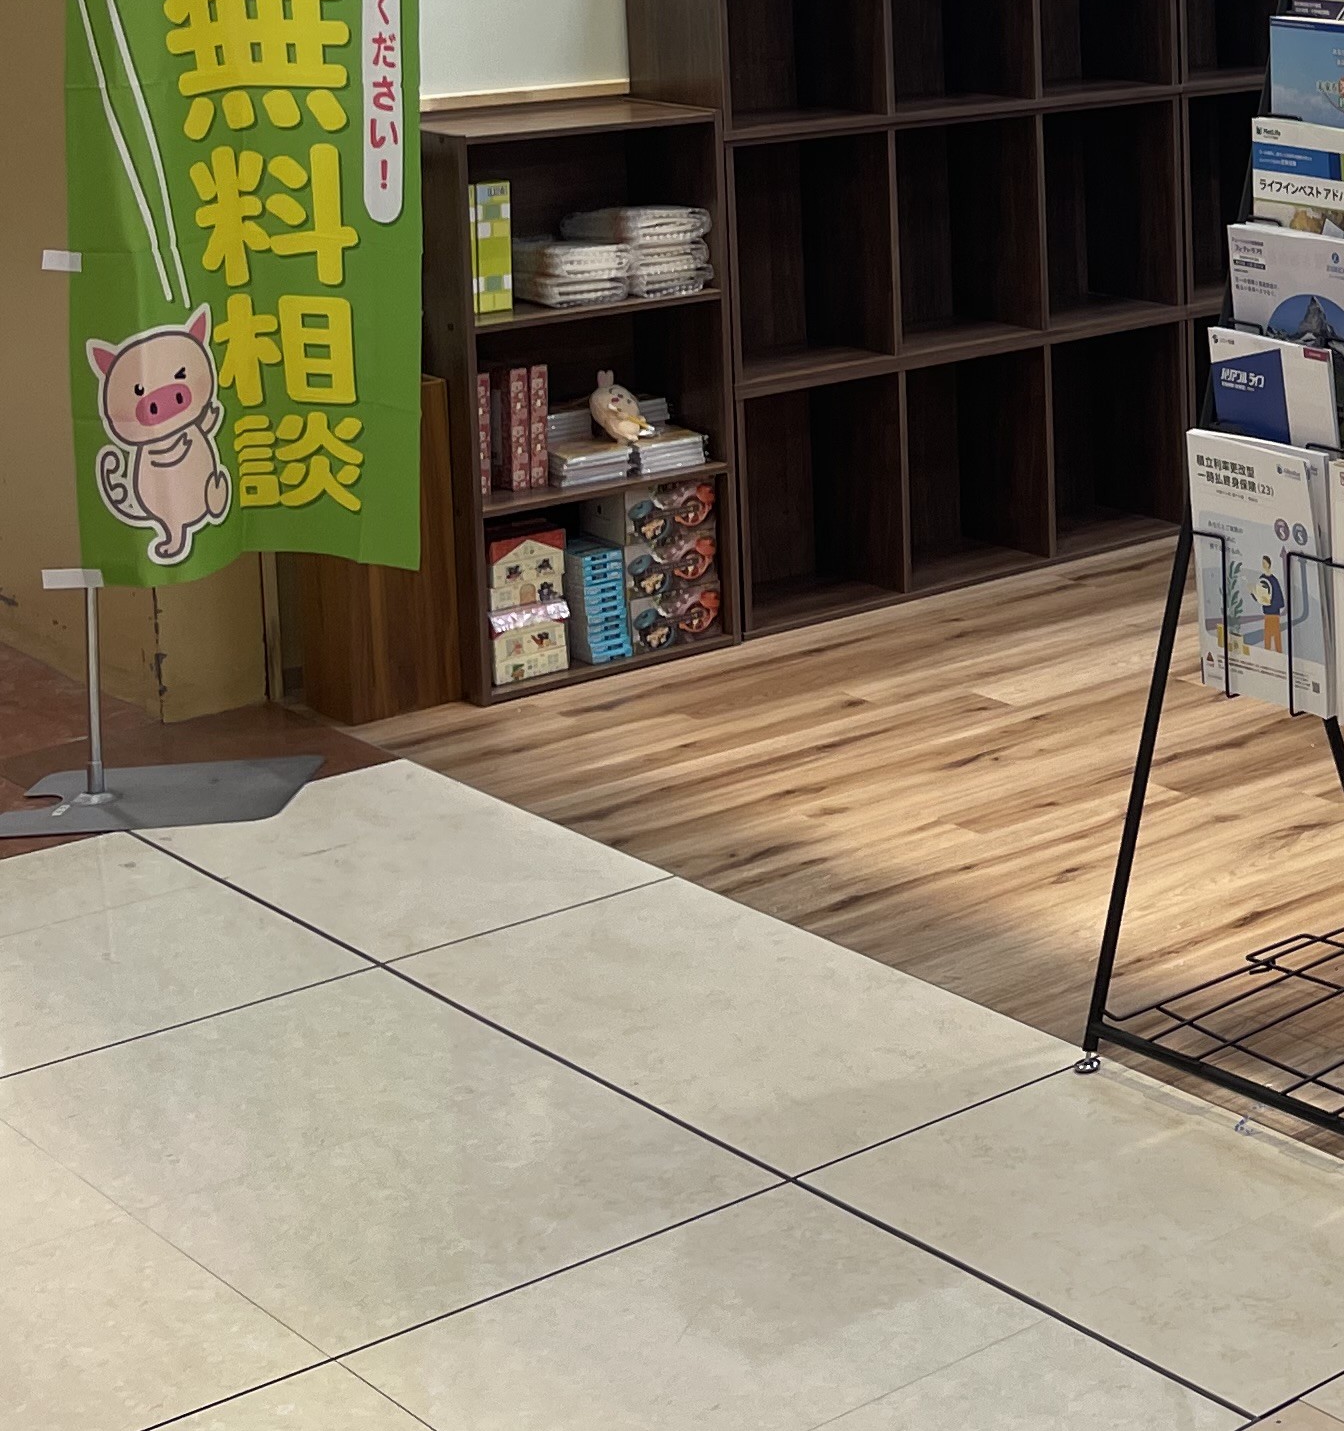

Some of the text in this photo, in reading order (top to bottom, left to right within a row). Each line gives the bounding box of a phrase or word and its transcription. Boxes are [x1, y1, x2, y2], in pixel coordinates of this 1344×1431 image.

[1259, 179, 1321, 198] ライフインベスト
